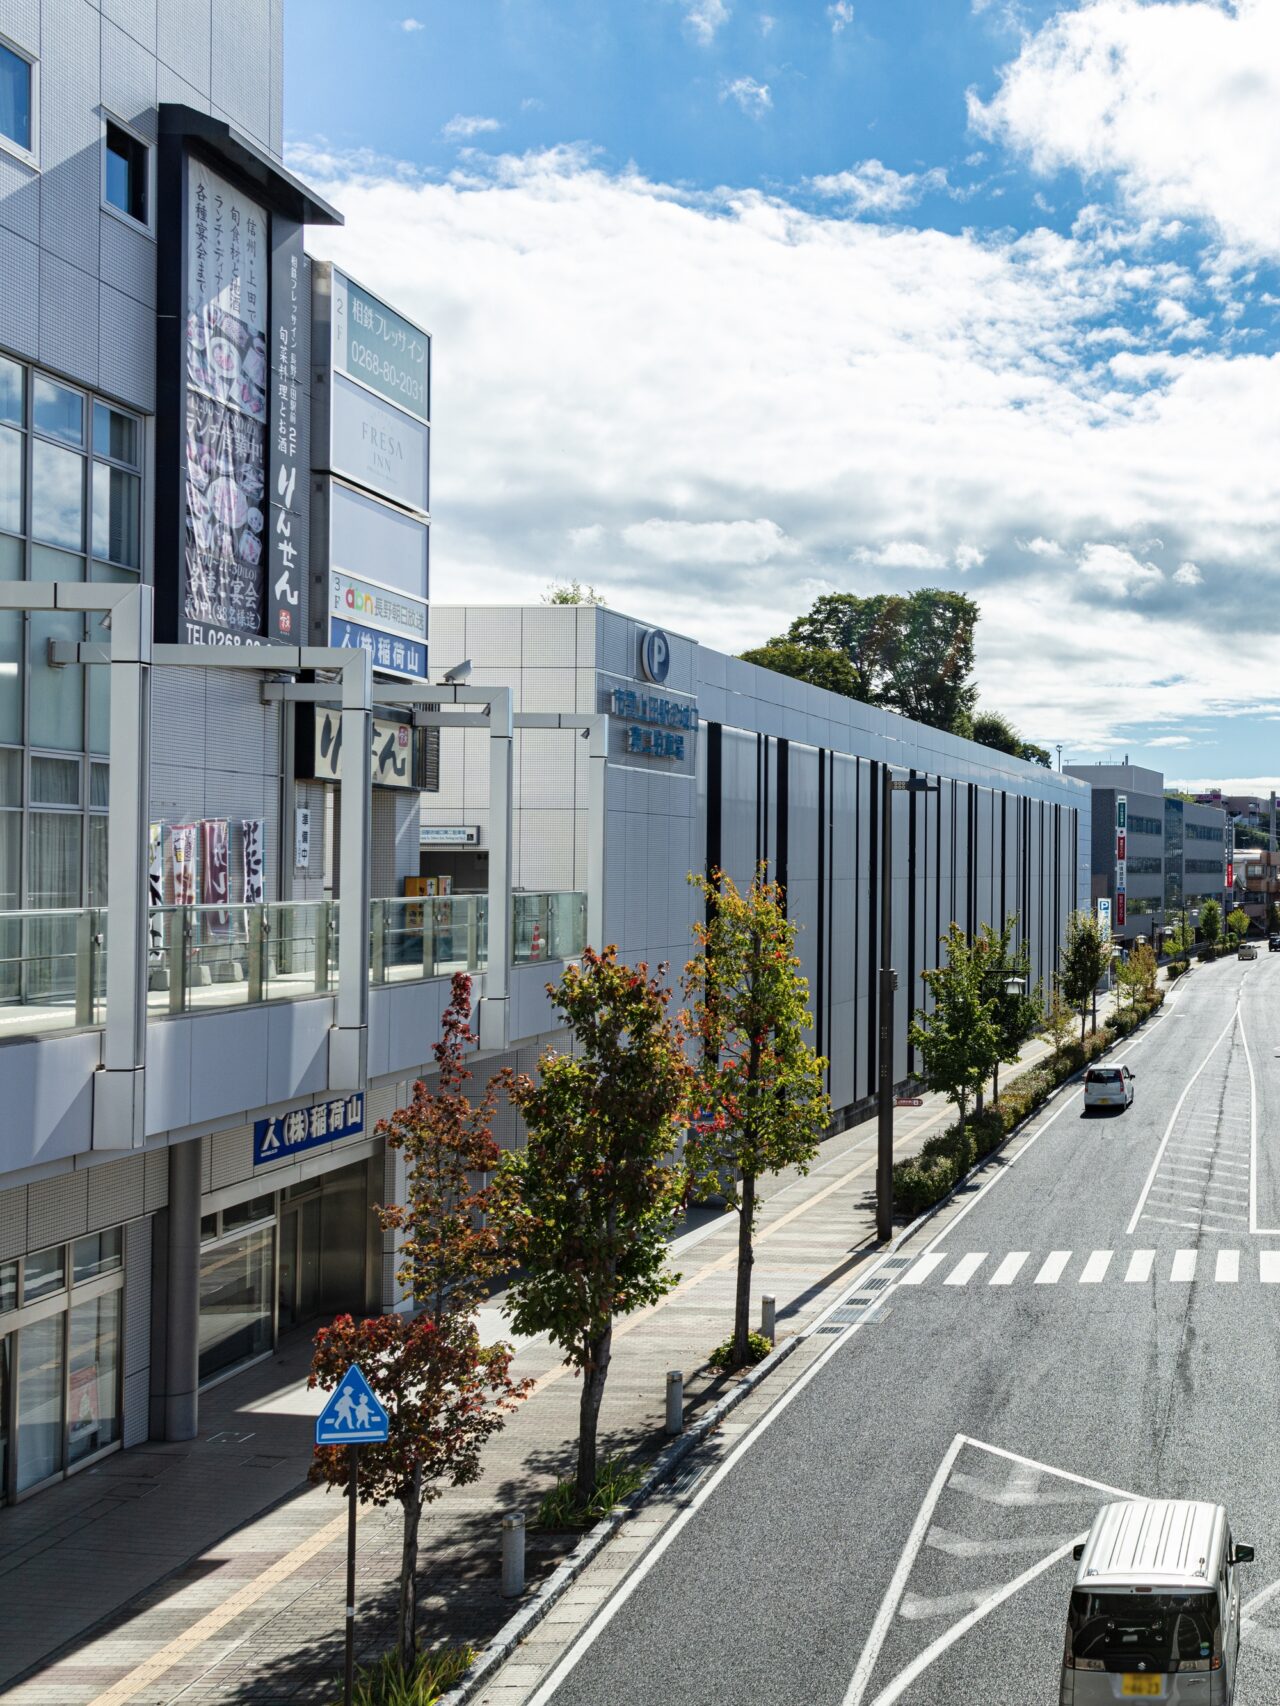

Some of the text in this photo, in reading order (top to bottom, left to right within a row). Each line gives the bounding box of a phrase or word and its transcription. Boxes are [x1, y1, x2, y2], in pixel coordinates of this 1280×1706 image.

[351, 297, 425, 364] 相鉄フレッサイン
[351, 340, 424, 404] 0268-80-2031
[275, 463, 299, 606] りんせん
[283, 1095, 362, 1147] (株)稲荷山
